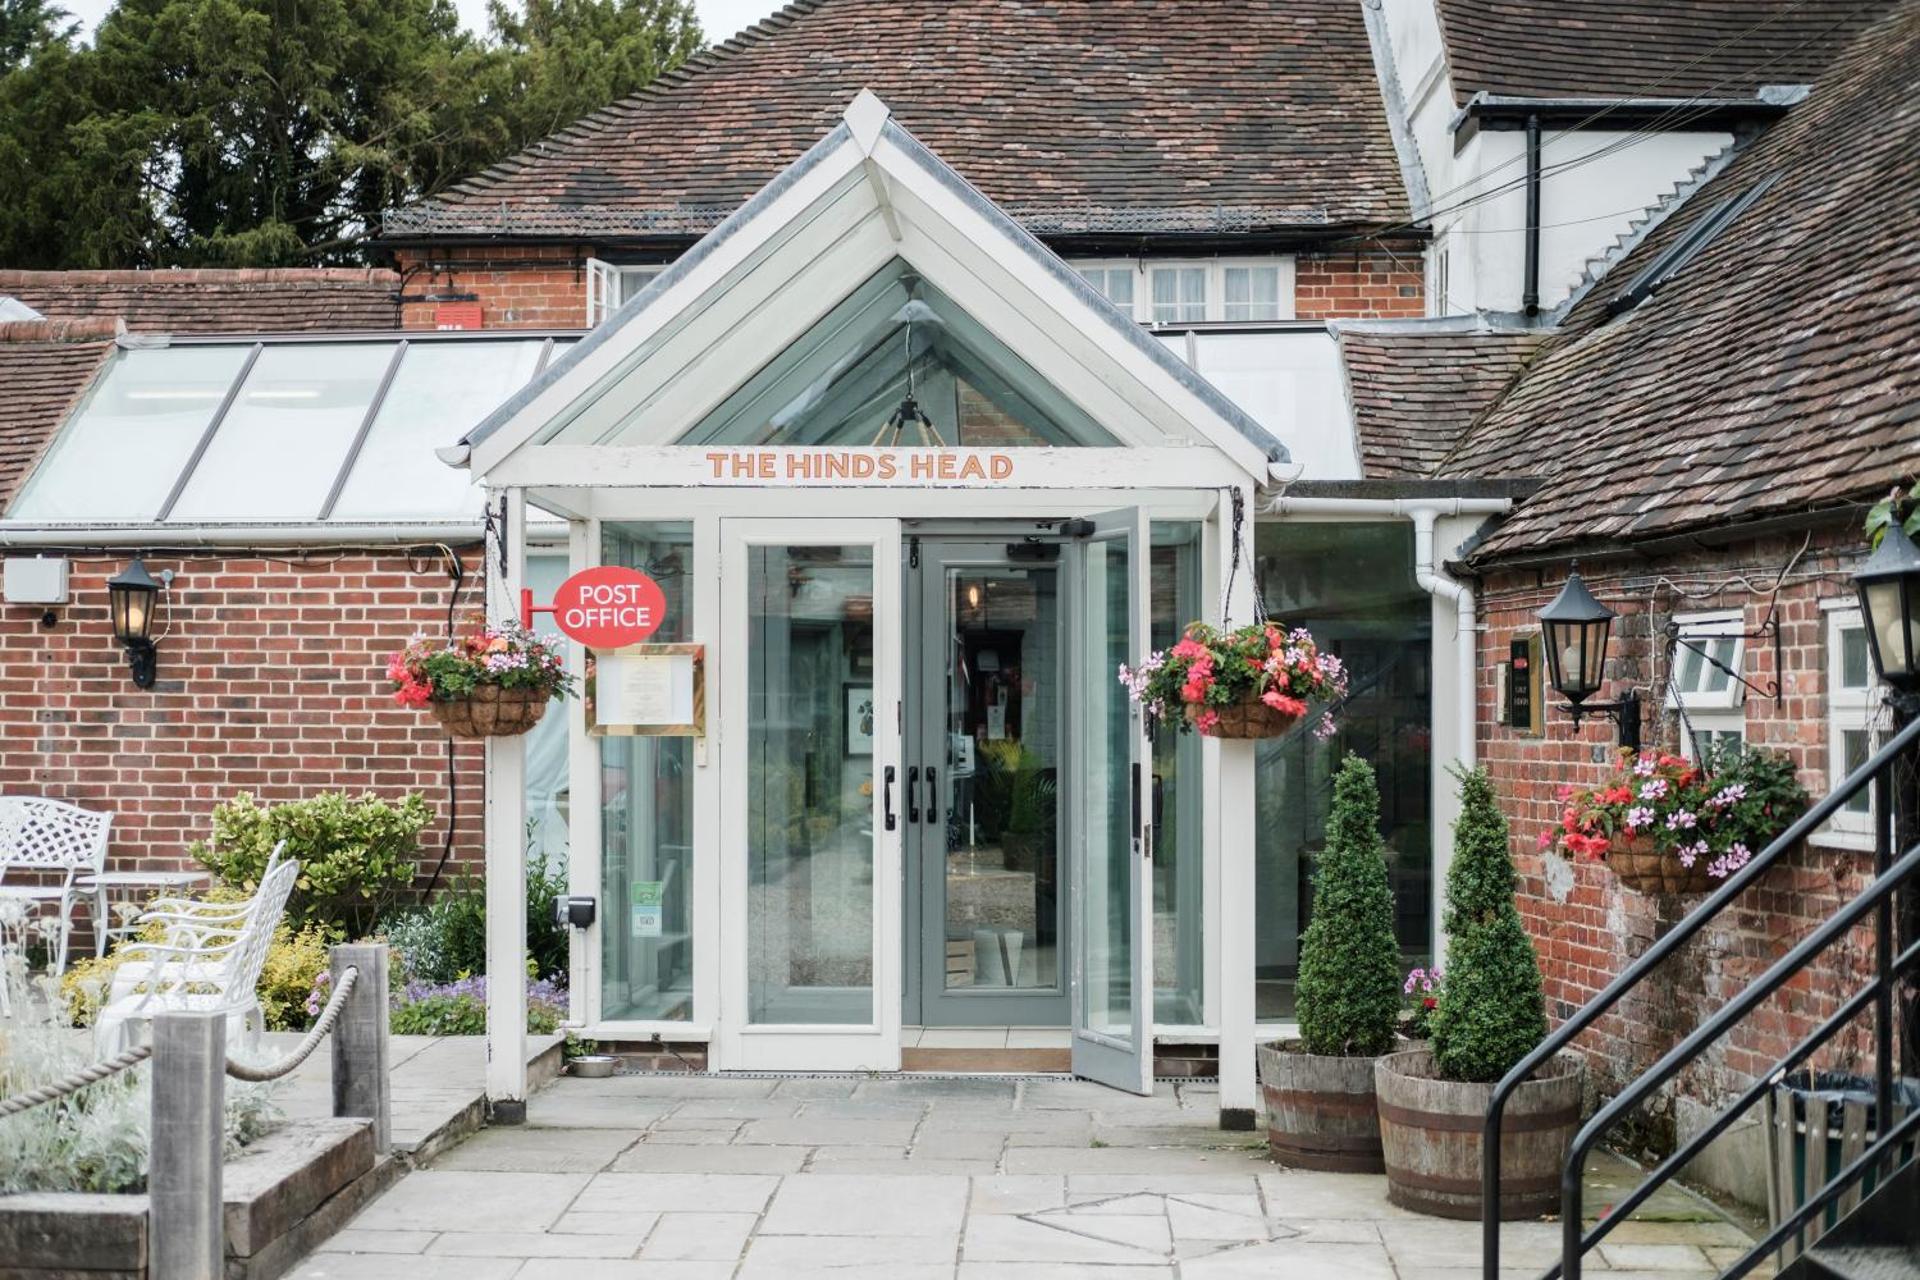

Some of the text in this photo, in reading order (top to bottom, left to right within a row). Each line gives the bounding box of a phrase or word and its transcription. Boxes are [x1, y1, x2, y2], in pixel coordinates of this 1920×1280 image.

[706, 453, 1014, 479] THE HINDS HEAD
[579, 584, 641, 605] POST
[565, 607, 651, 628] OFFICE
